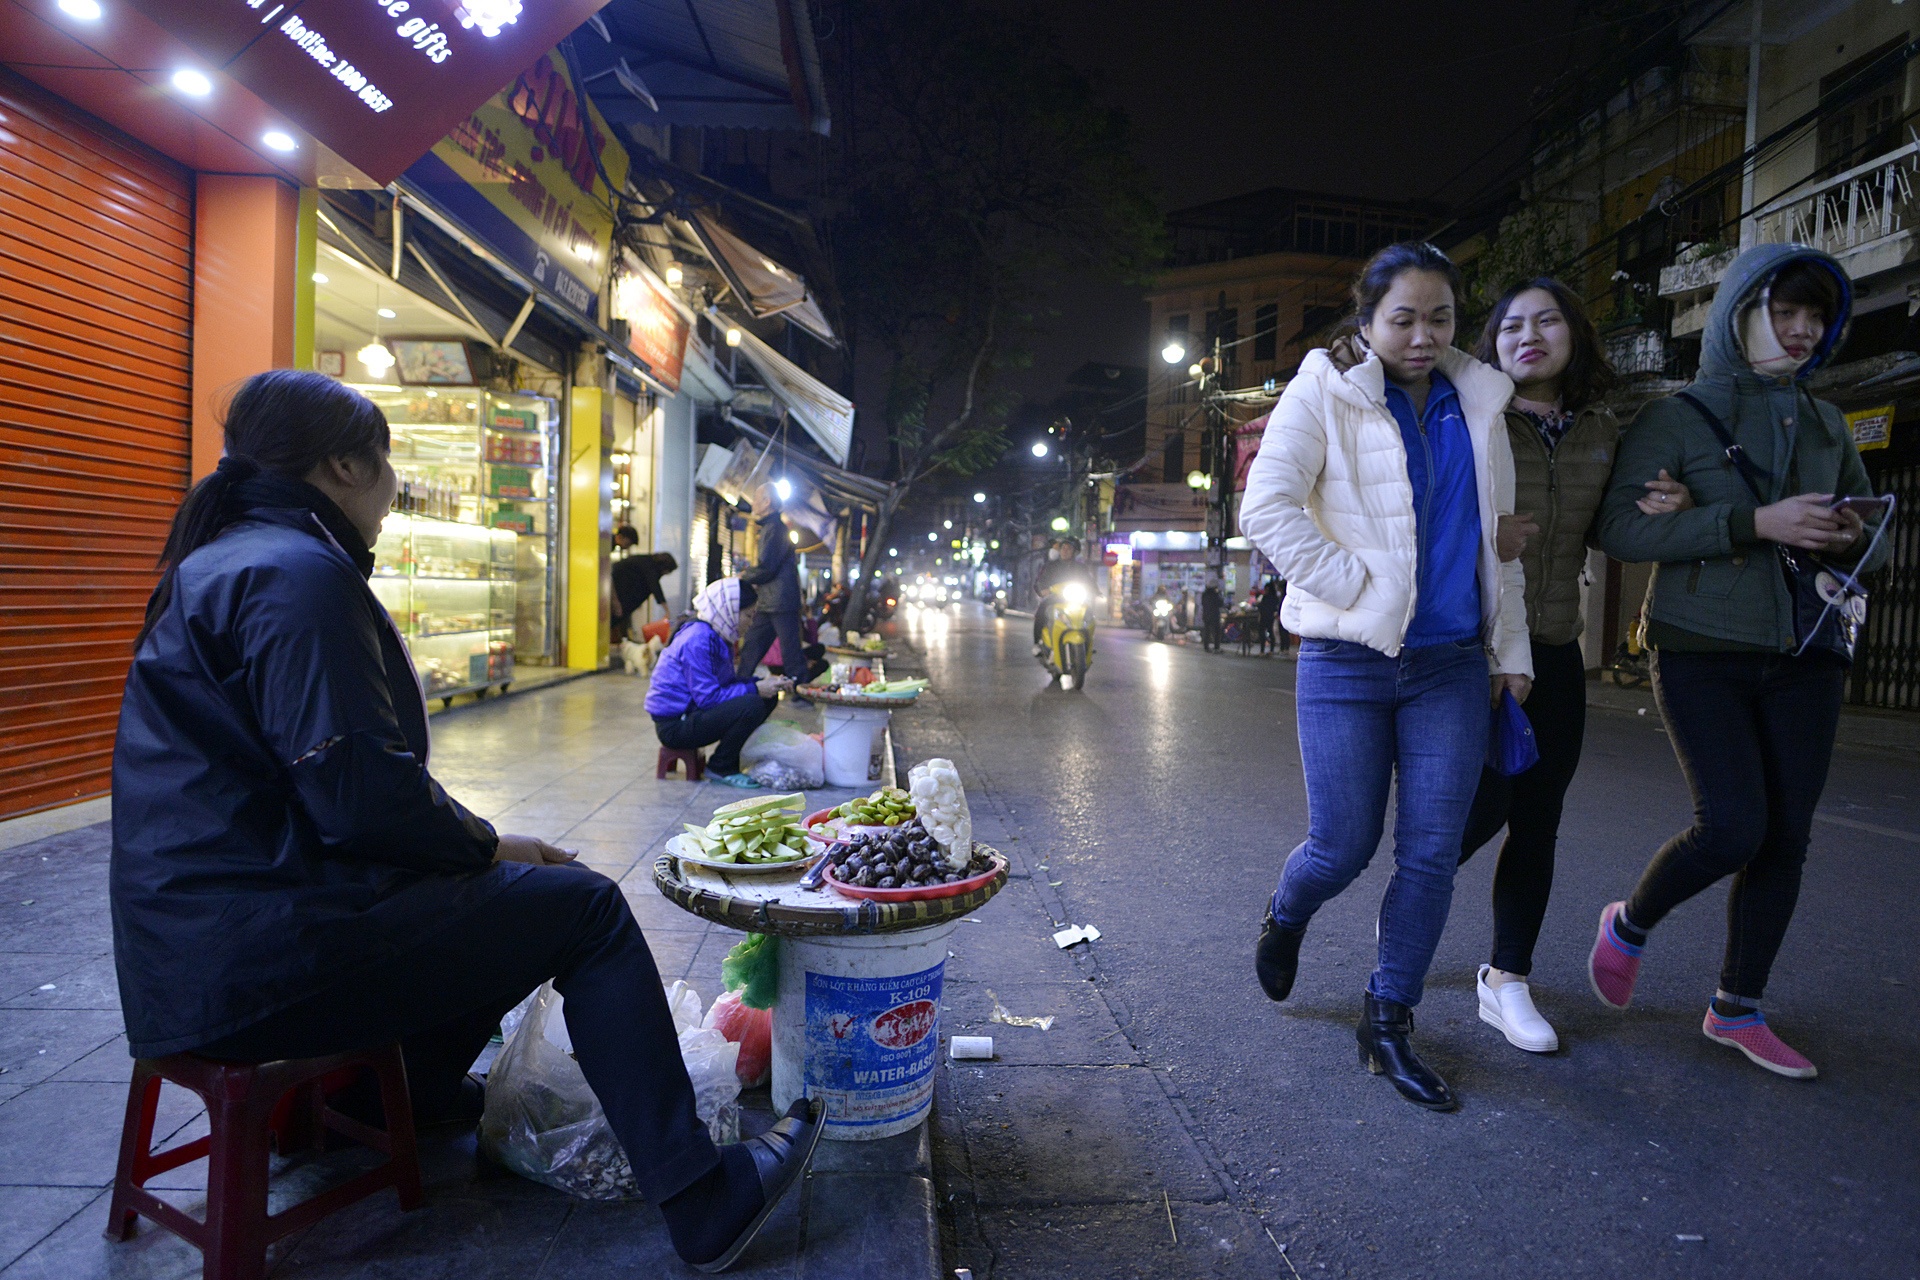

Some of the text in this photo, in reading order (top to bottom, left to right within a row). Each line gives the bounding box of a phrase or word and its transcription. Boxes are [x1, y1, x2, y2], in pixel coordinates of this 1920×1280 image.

[396, 17, 453, 64] gifts
[280, 15, 394, 113] Hotline: 1800 6657
[889, 984, 931, 1005] K-109
[877, 1009, 933, 1039] KOVA
[880, 1053, 895, 1063] ISO
